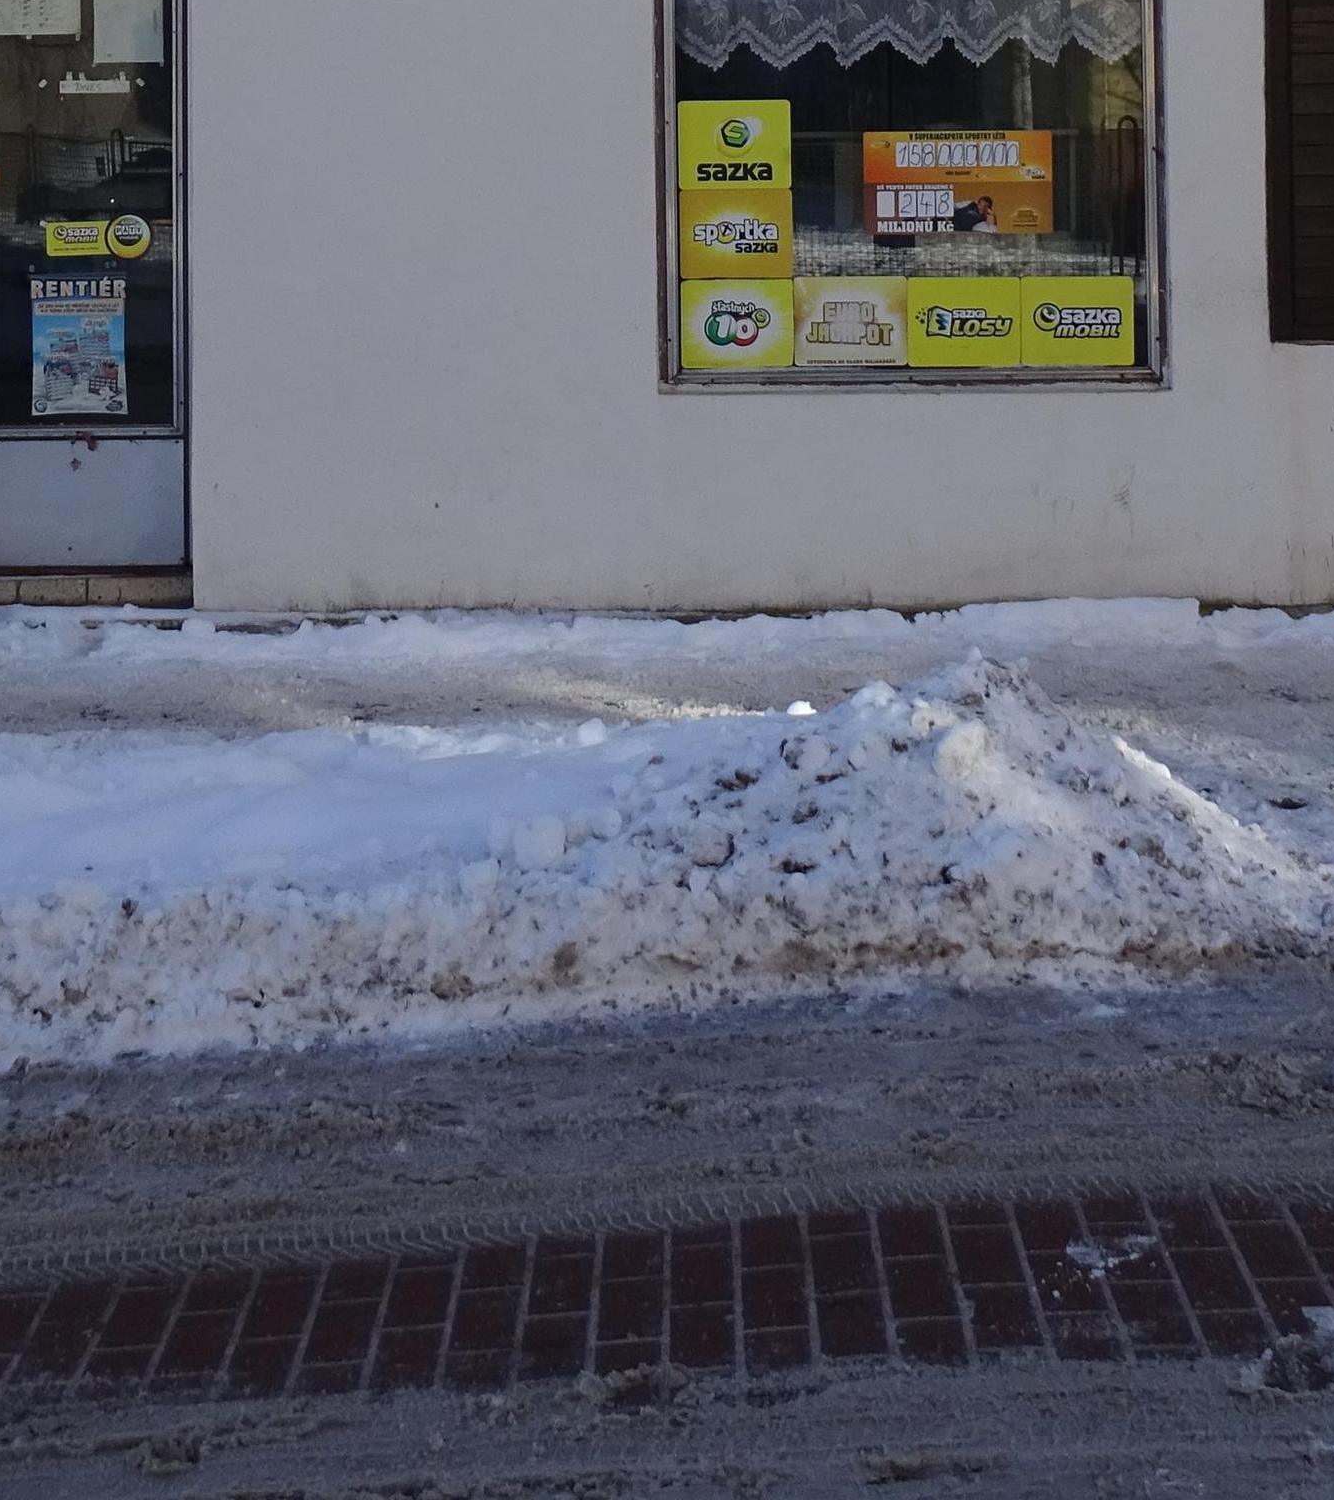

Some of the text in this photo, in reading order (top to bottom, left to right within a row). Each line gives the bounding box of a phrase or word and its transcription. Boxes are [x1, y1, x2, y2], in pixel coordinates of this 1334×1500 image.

[898, 142, 935, 167] 158
[697, 162, 773, 182] sazka
[900, 191, 950, 215] 248
[67, 227, 99, 236] sazka
[694, 219, 779, 246] sportka
[877, 217, 954, 233] MILIONŮ Kč
[735, 241, 778, 254] sazka
[30, 275, 127, 300] RENTIÉR
[824, 301, 875, 323] EURO
[952, 309, 986, 319] sazka
[1061, 308, 1121, 324] sazka
[1054, 324, 1120, 338] MOBIL
